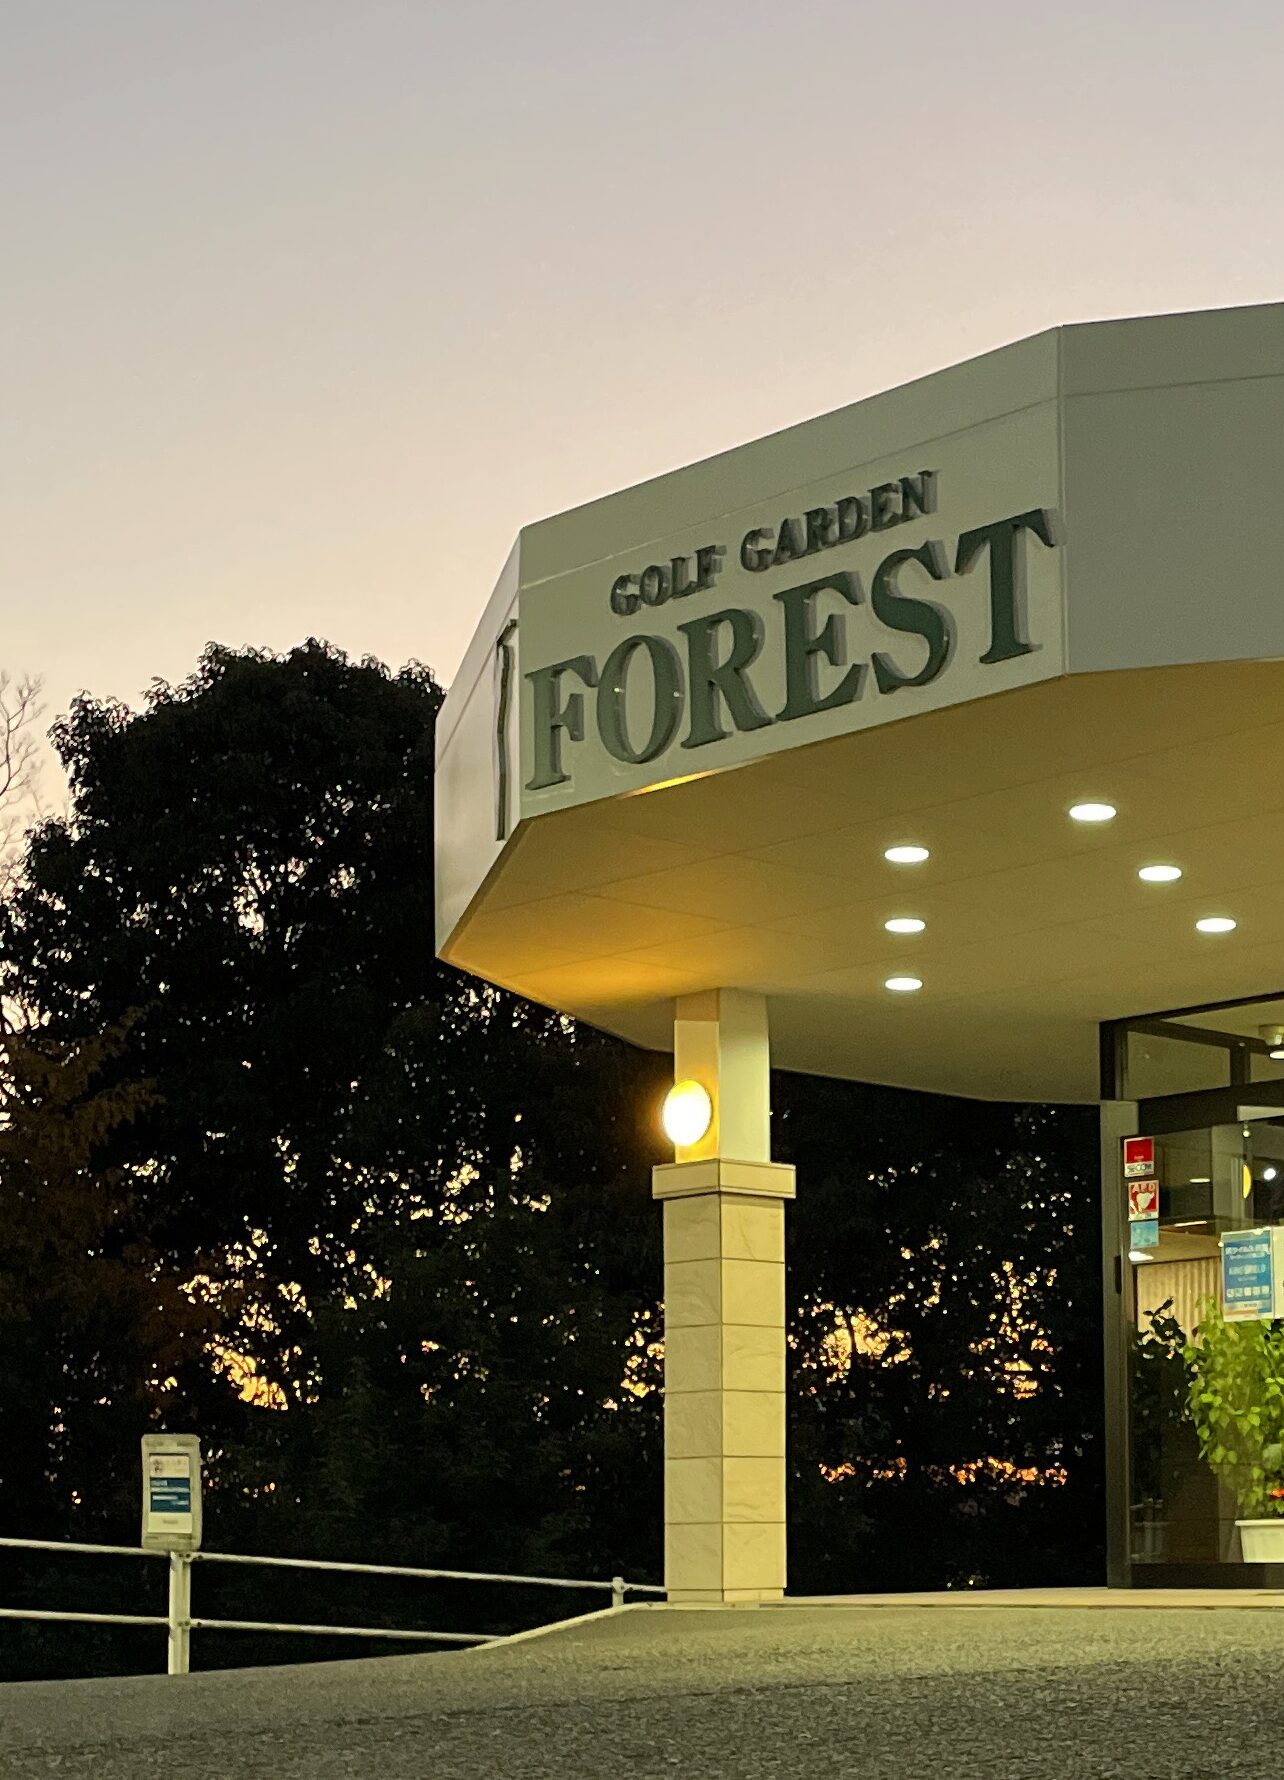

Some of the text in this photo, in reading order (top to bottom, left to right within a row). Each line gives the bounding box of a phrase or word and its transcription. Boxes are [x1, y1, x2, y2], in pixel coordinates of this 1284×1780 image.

[524, 508, 1060, 792] FOREST
[610, 469, 938, 617] GOLF GARDEN
